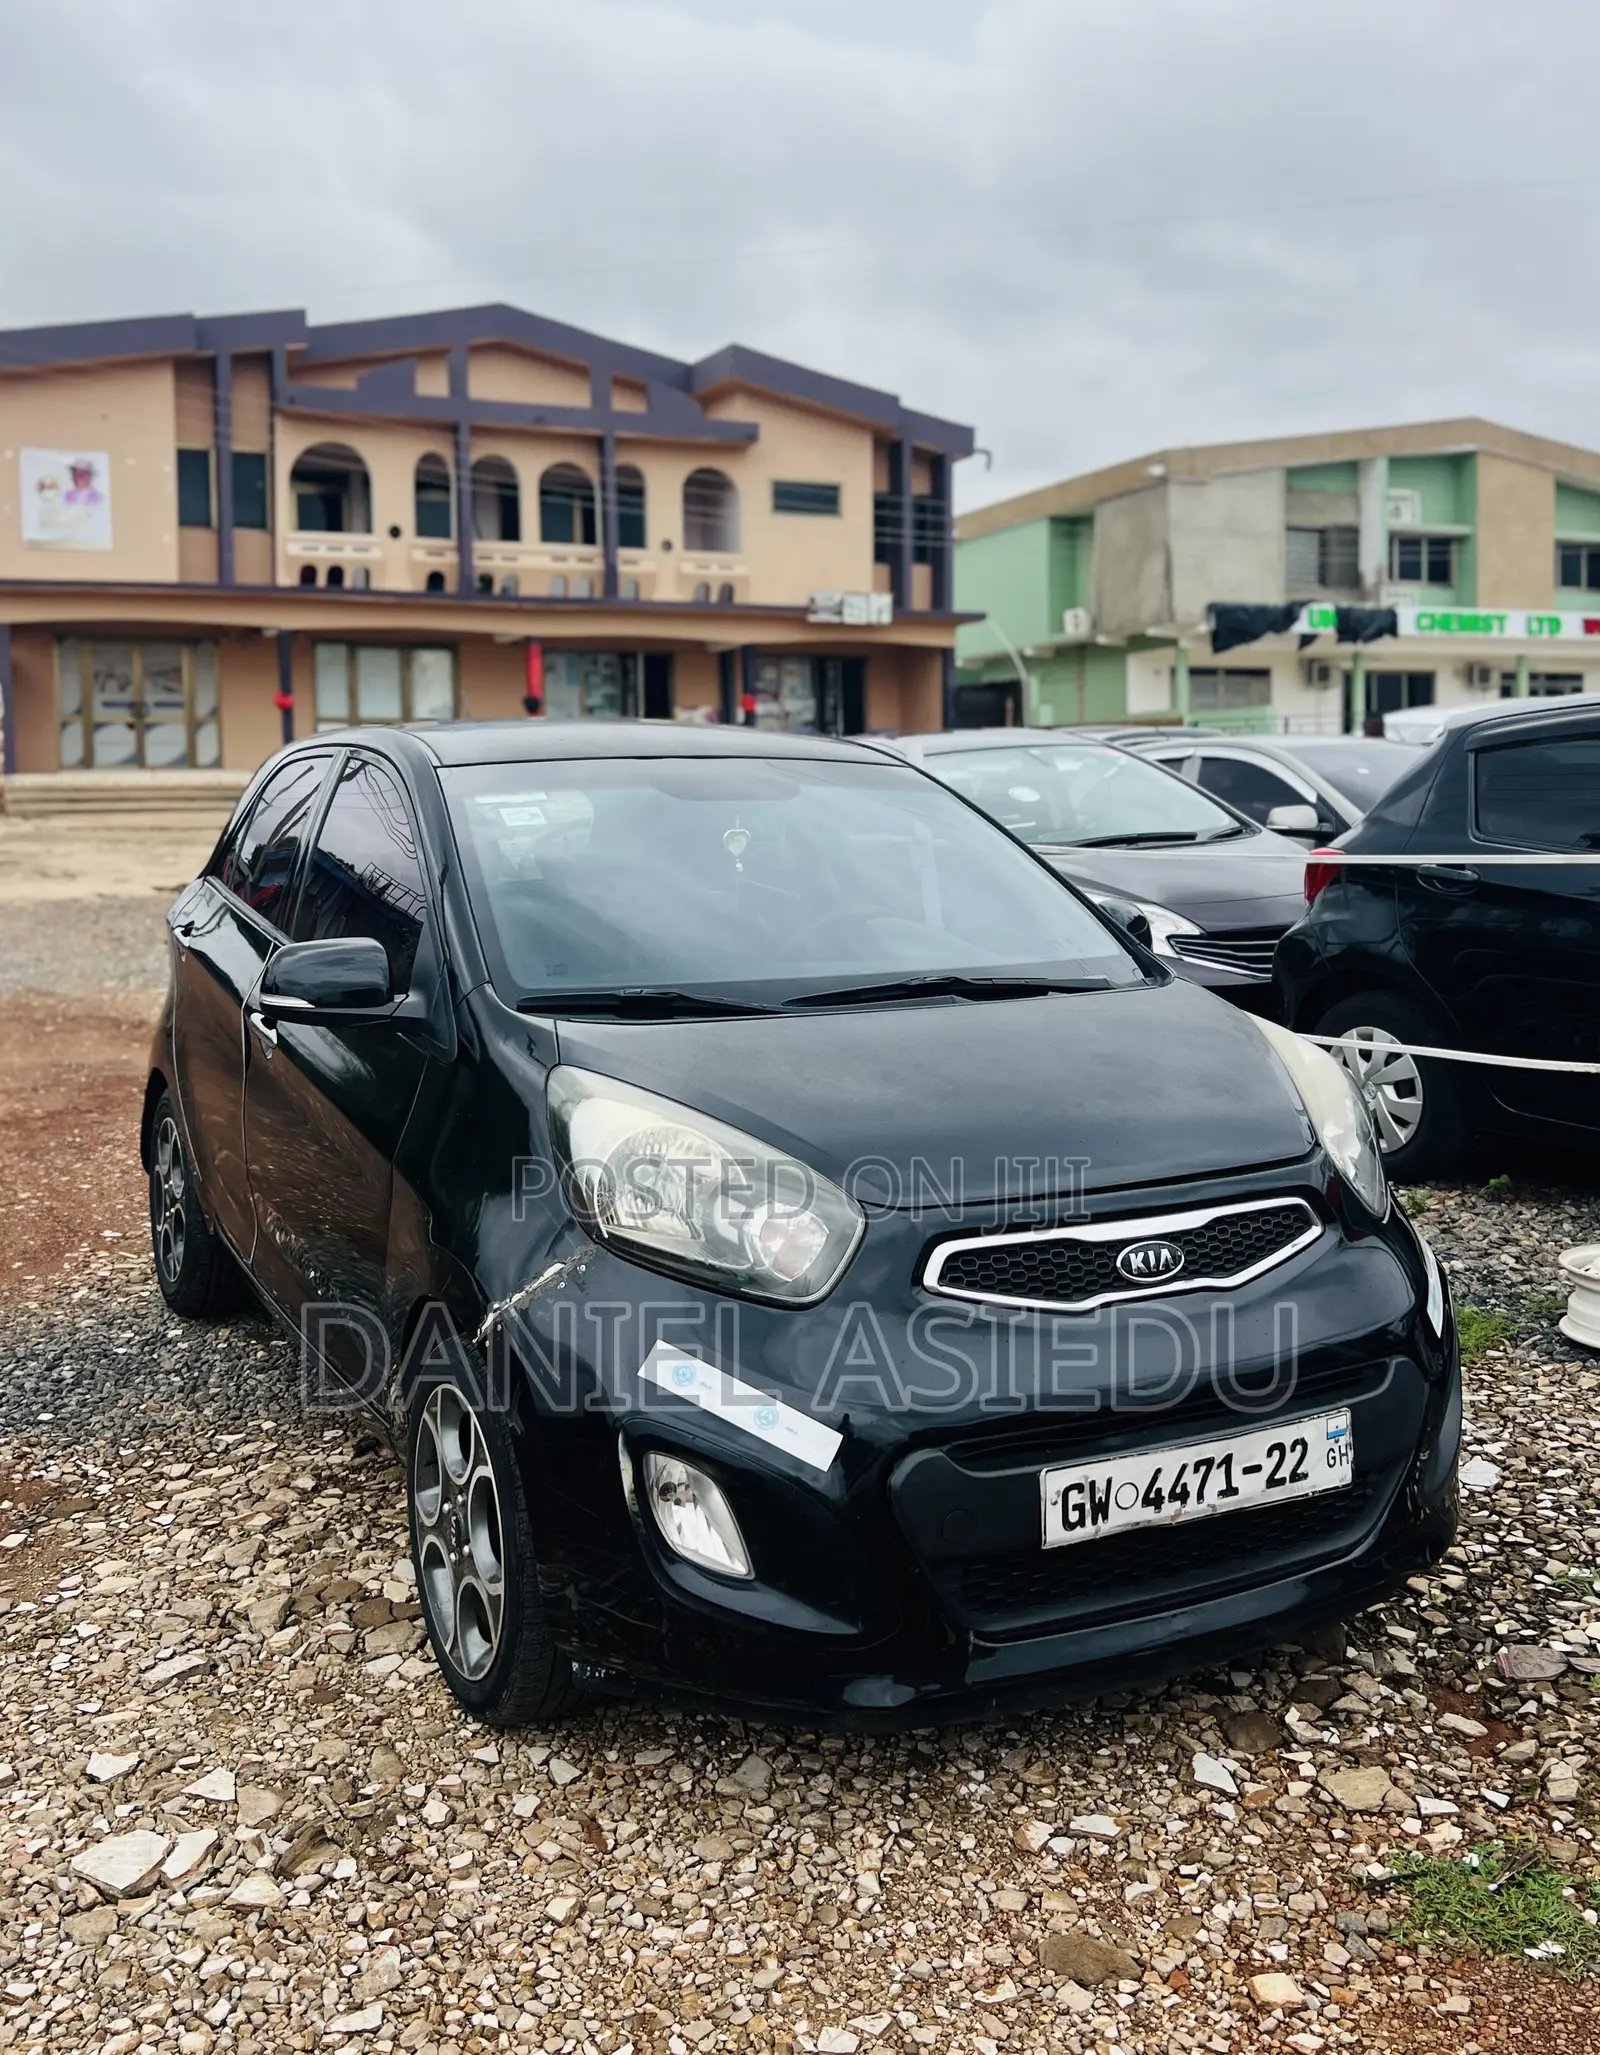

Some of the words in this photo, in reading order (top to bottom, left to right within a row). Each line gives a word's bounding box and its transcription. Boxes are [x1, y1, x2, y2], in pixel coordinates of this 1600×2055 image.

[1416, 612, 1508, 634] CHEMIST
[1527, 615, 1563, 636] LTD
[1128, 1248, 1176, 1275] KIA
[1326, 1444, 1350, 1468] GH
